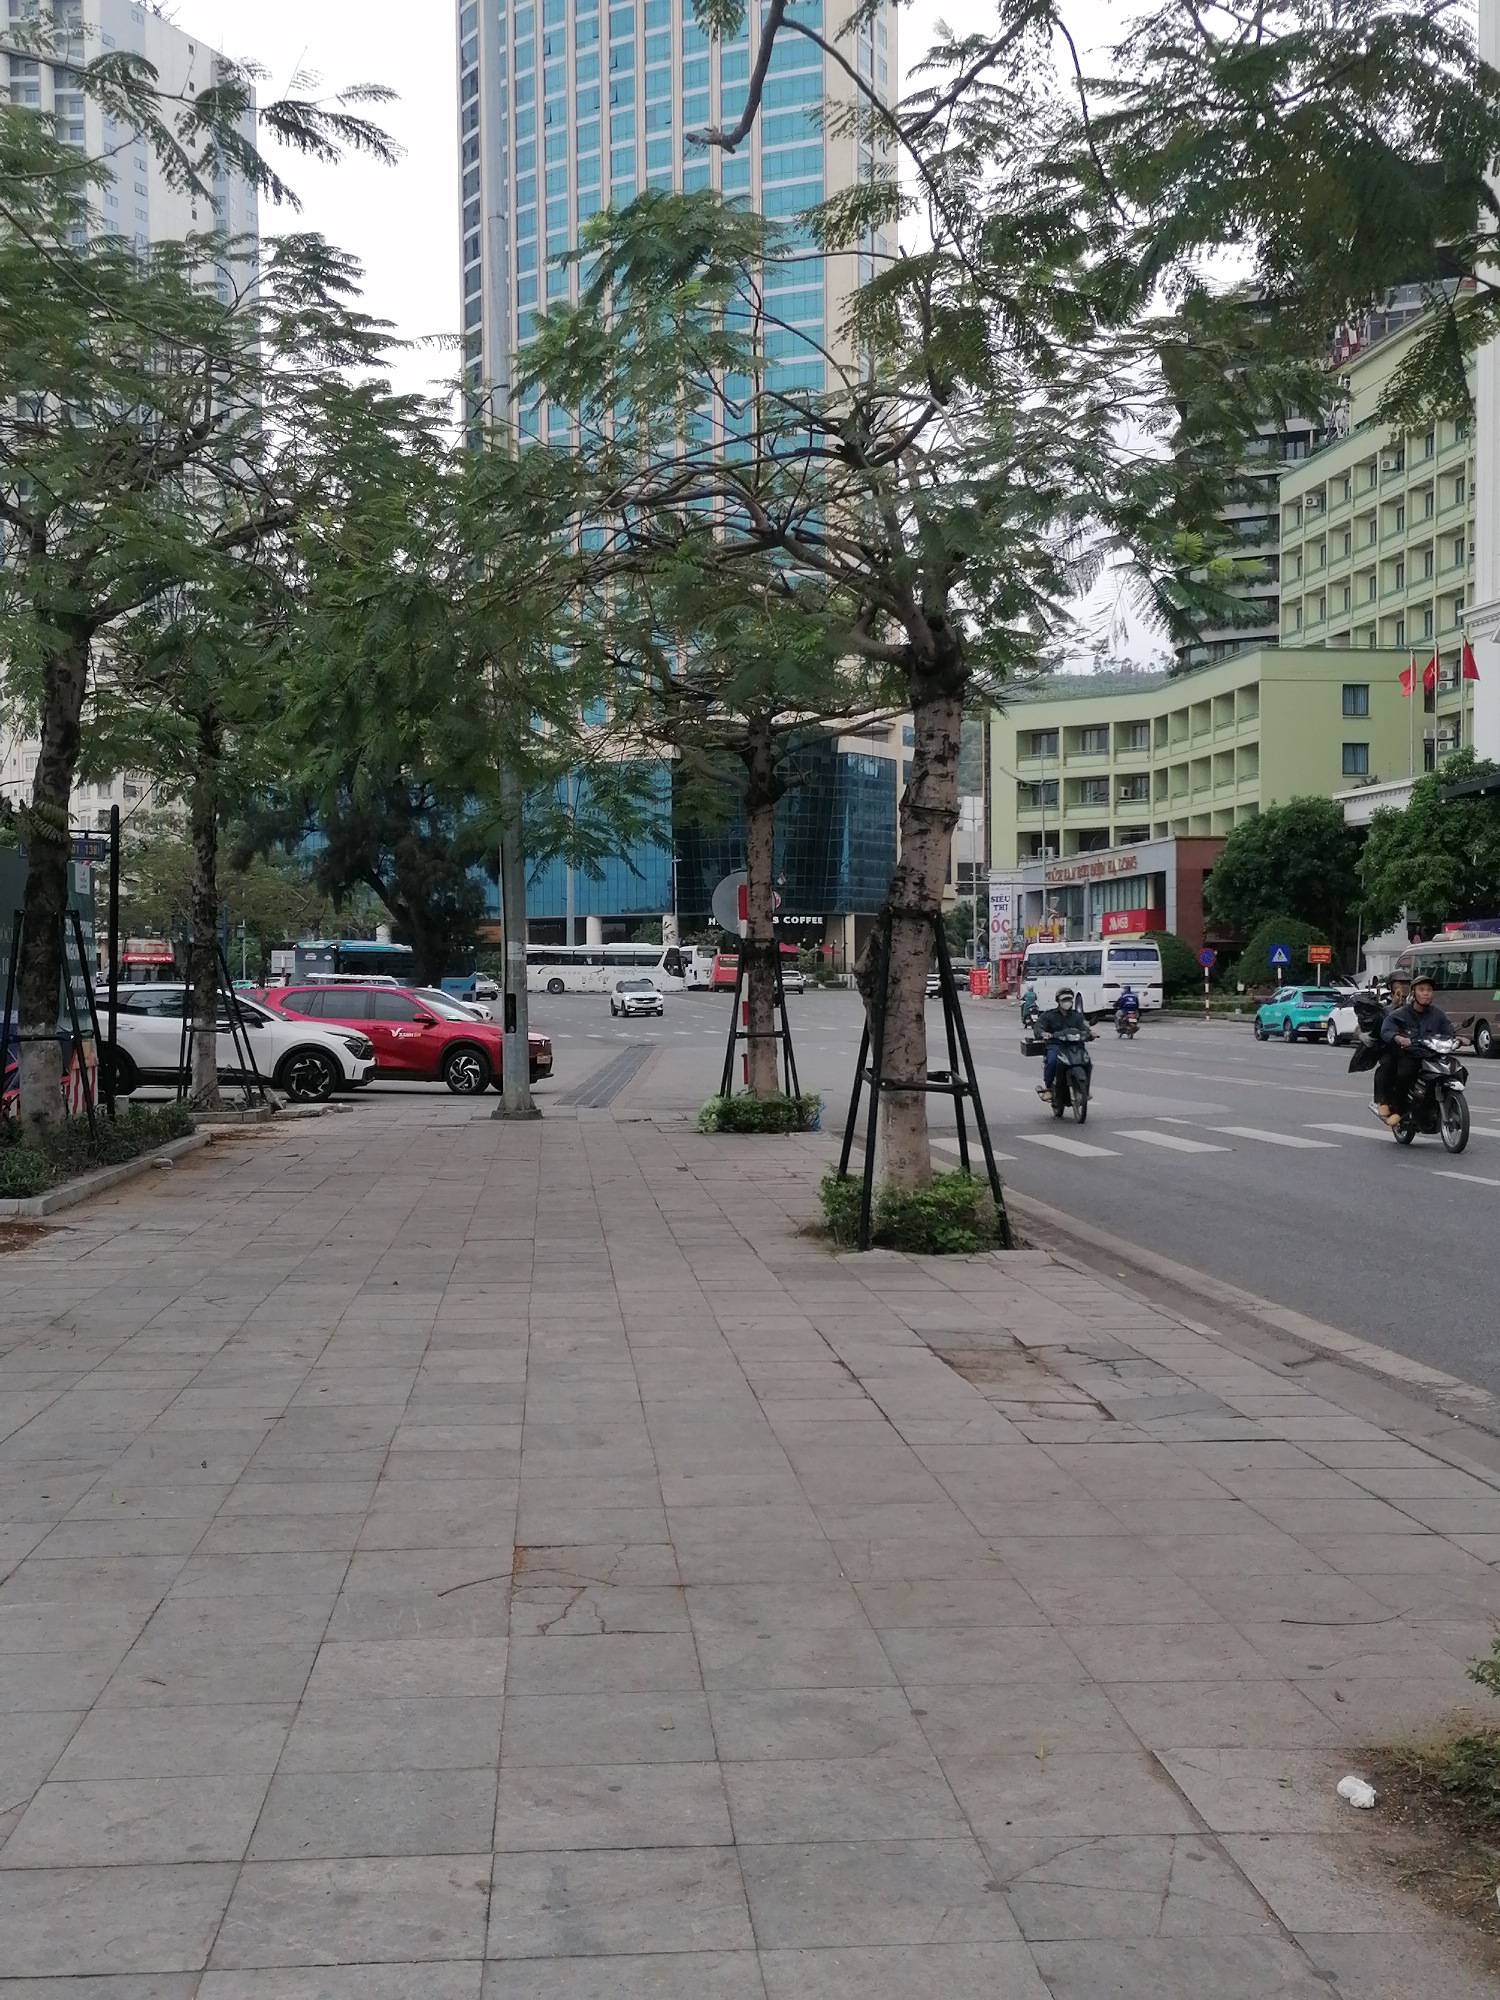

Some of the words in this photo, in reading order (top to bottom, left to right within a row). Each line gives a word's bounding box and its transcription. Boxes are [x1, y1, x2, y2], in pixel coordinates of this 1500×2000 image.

[990, 893, 1010, 903] SIÊU
[993, 904, 1008, 913] THỊ
[782, 916, 823, 925] COFFEE
[990, 912, 1010, 933] ỐC
